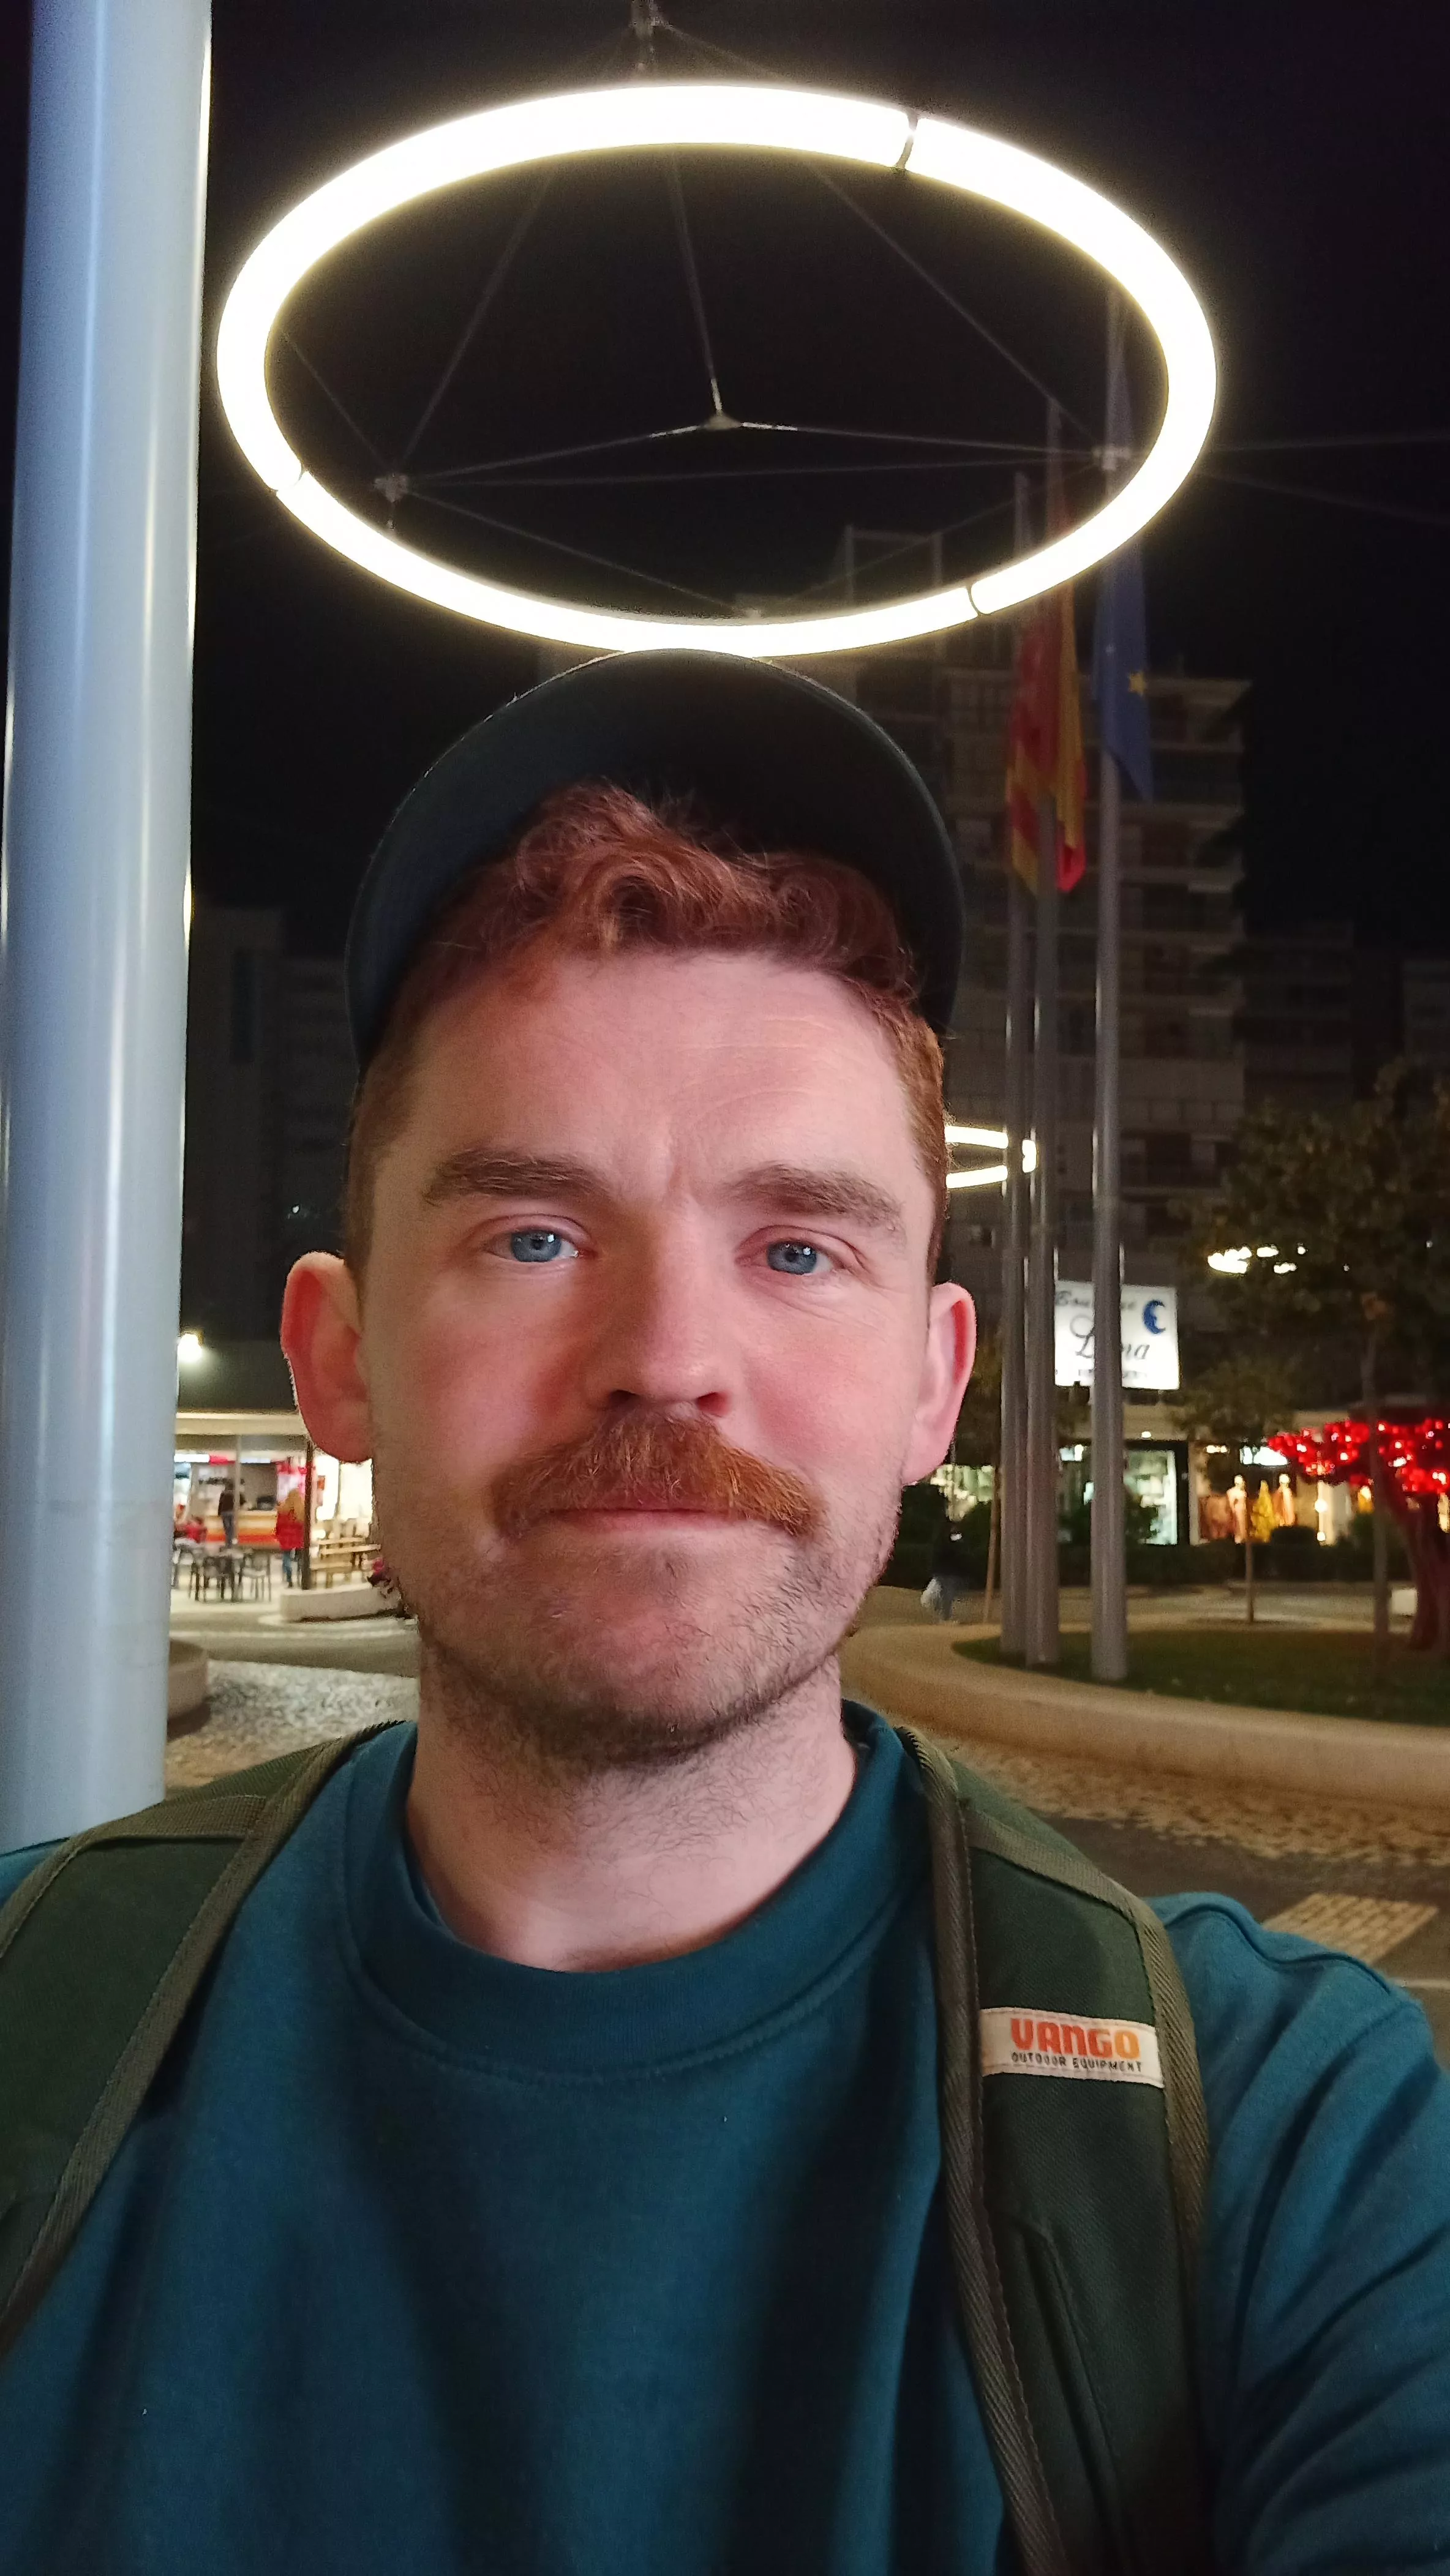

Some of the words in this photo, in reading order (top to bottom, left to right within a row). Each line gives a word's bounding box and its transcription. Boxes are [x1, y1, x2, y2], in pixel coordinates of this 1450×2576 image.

[1011, 2018, 1140, 2060] VANGO
[1011, 2052, 1067, 2067] OUTDOOR
[1072, 2057, 1142, 2073] EQUIPMENT
